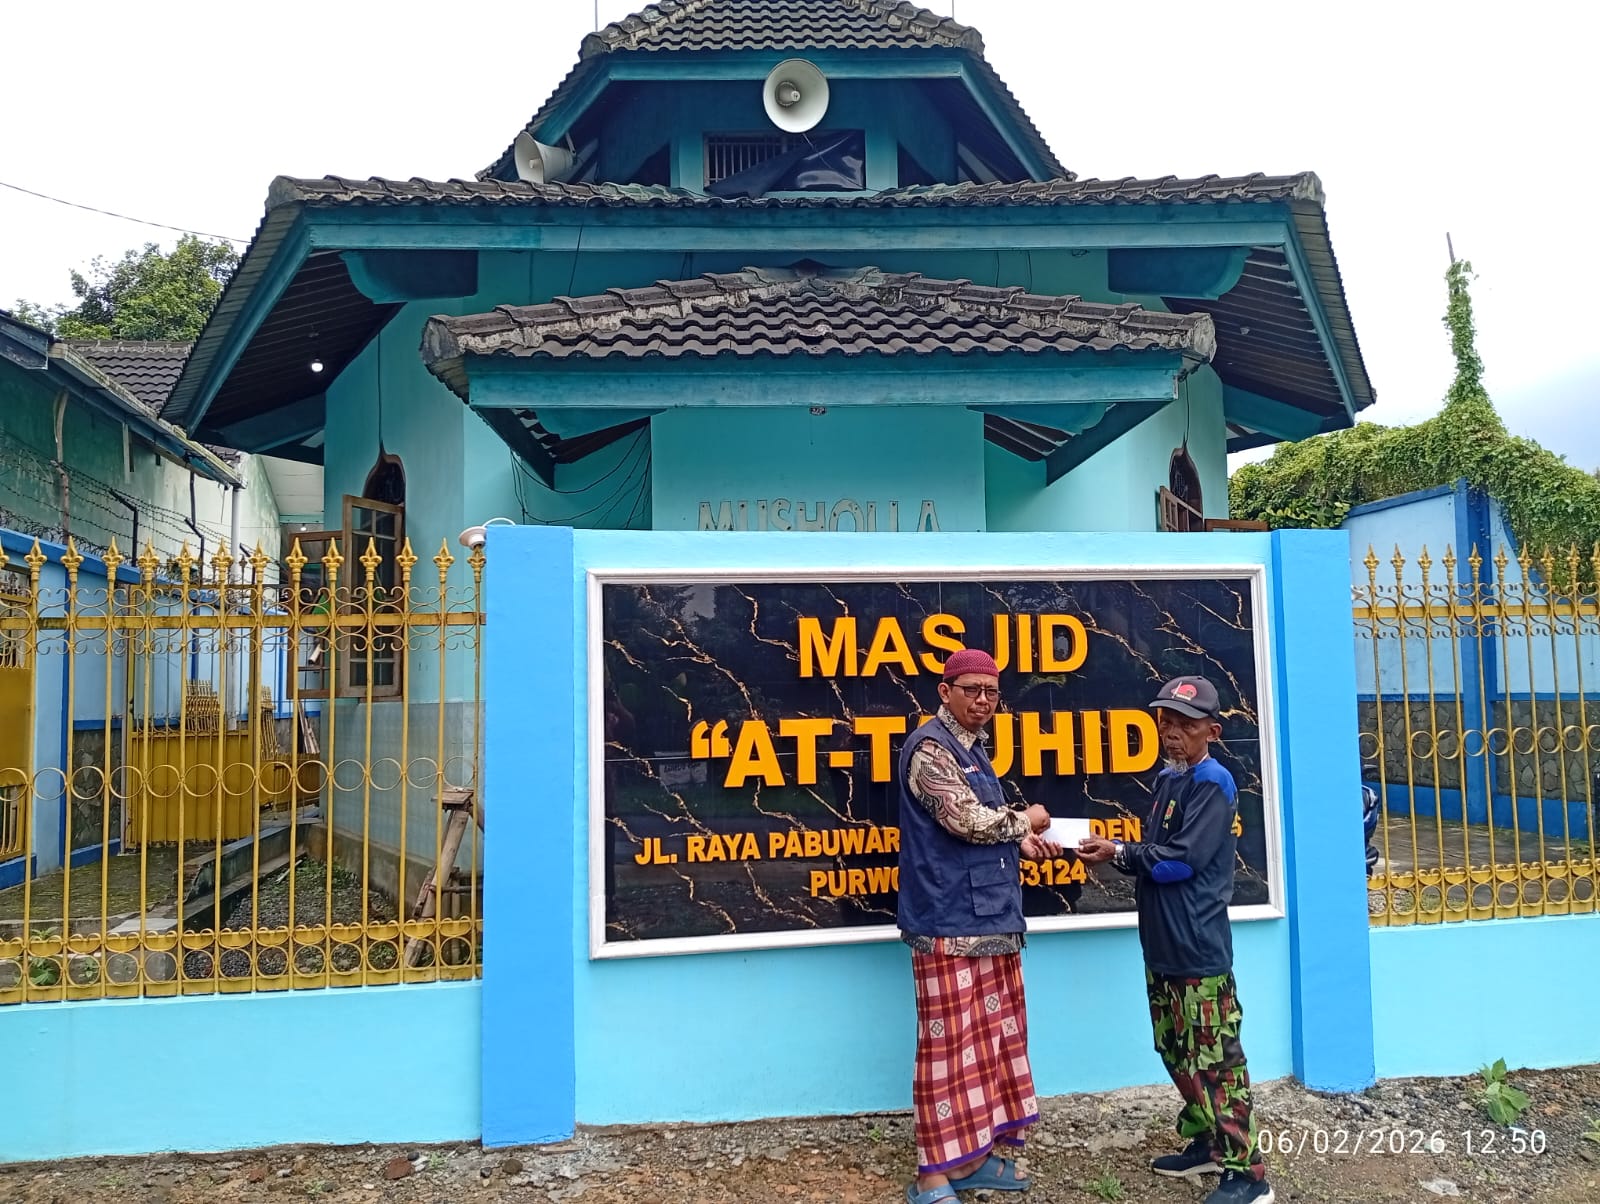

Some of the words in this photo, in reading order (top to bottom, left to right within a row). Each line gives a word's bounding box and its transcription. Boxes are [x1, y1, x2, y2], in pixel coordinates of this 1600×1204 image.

[798, 613, 1088, 677] MASJID
[634, 837, 678, 866] JL.
[687, 832, 761, 863] RAYA
[1019, 858, 1087, 886] 3124
